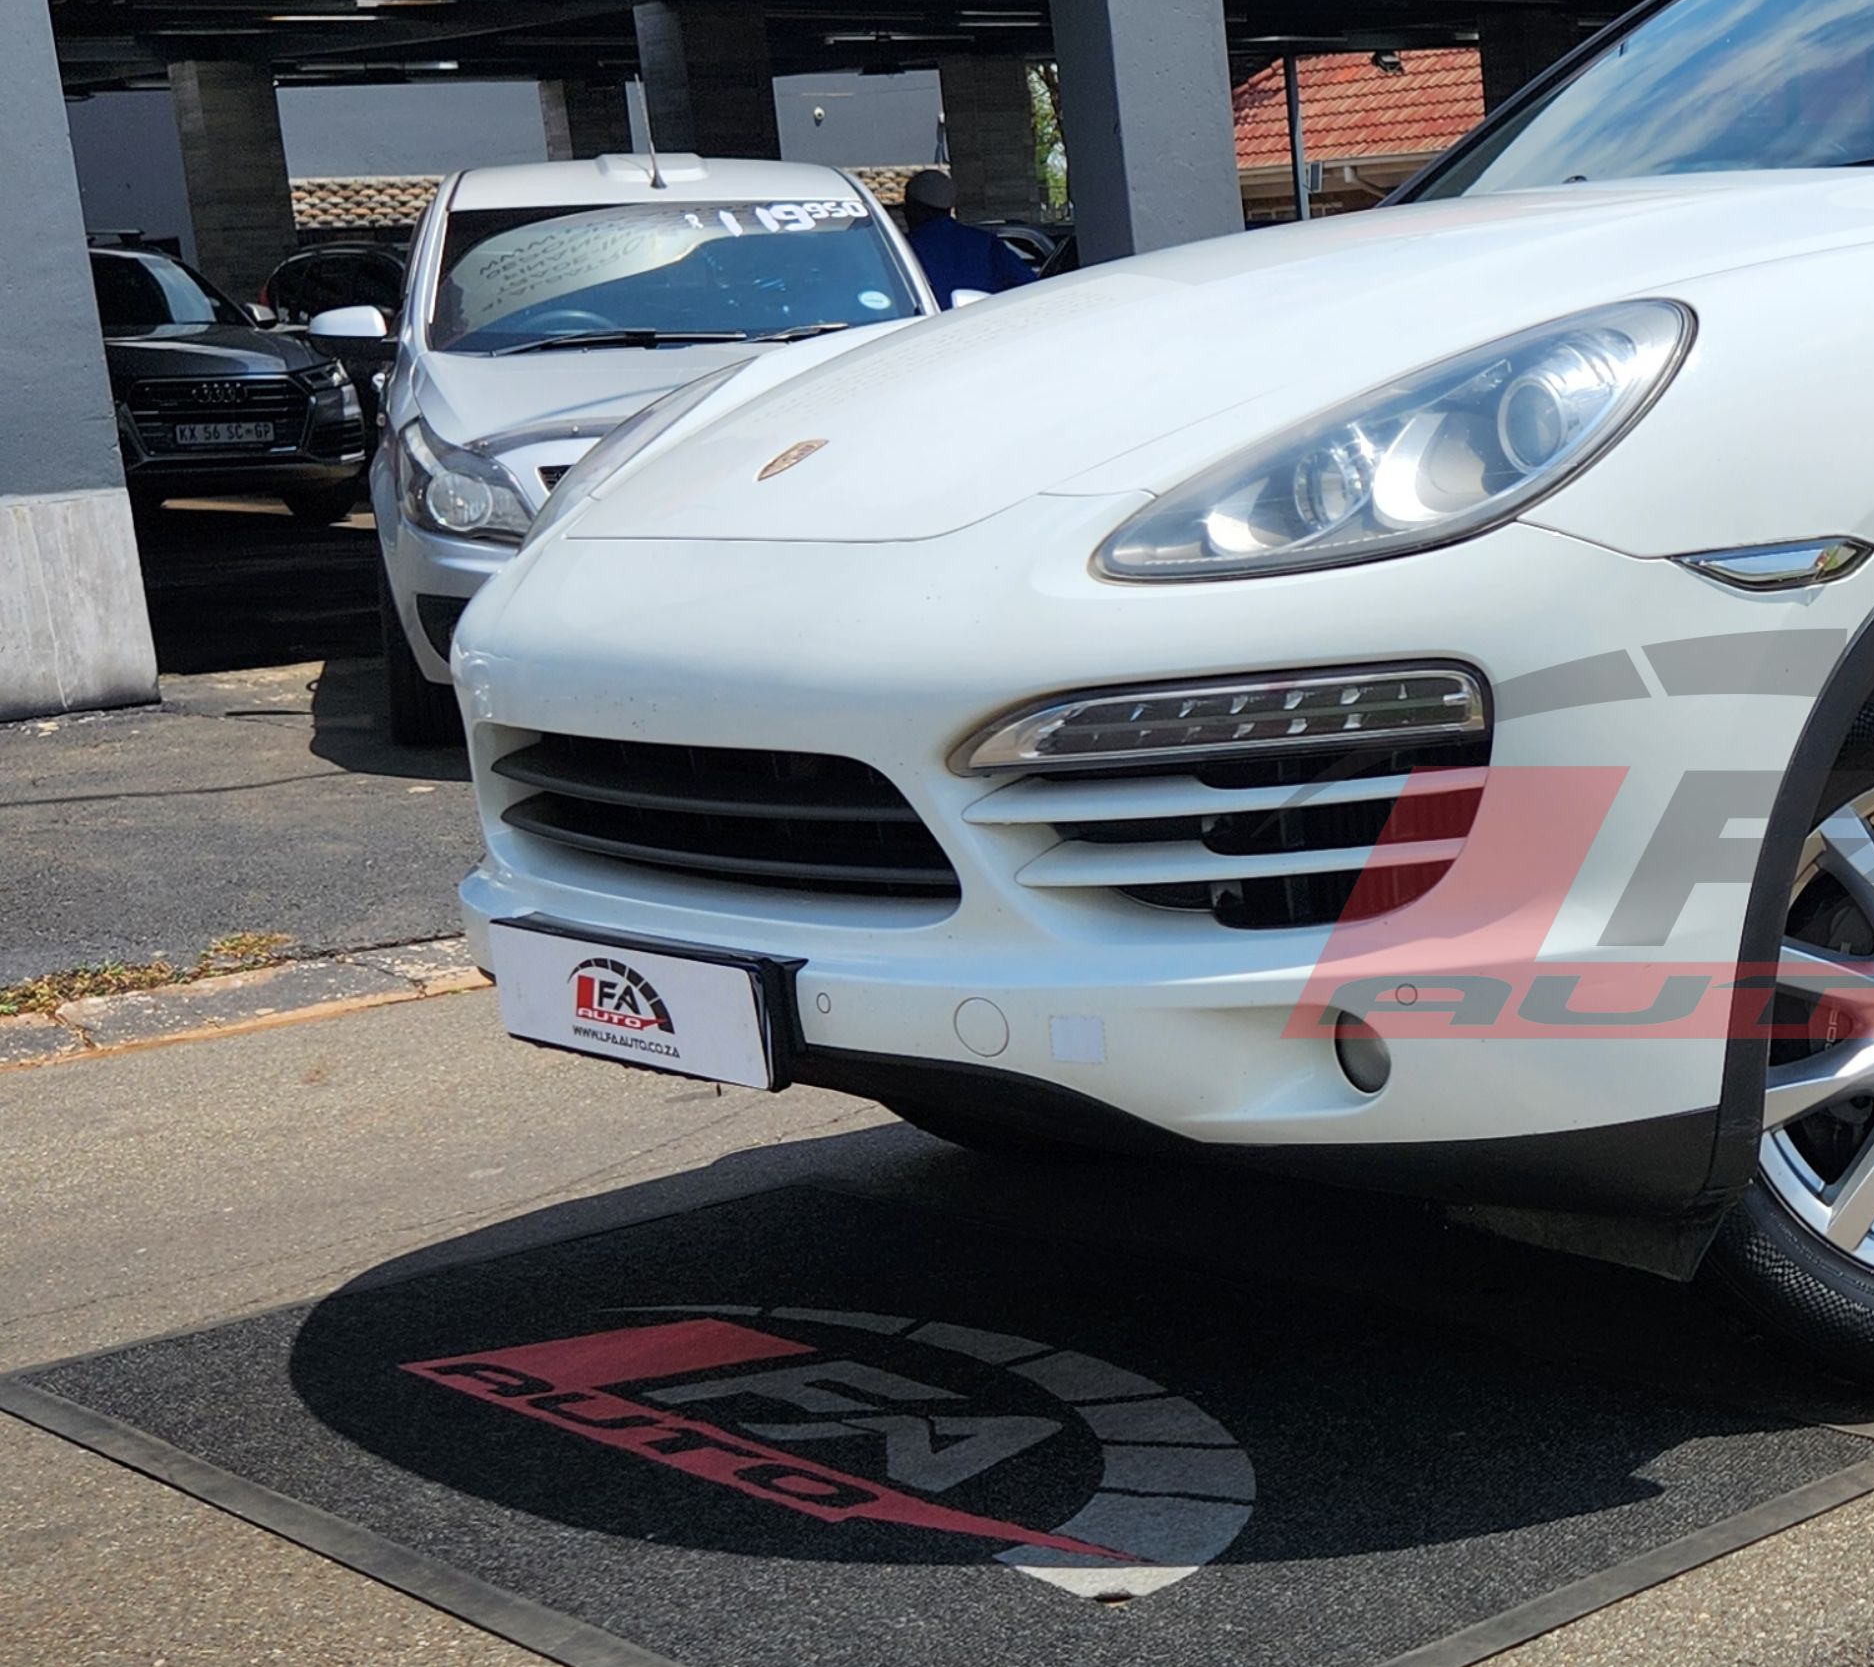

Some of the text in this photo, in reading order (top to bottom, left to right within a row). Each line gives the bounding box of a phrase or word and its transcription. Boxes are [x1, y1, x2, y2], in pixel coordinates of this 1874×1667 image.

[576, 975, 642, 1015] LFA
[578, 1008, 642, 1027] AUTO
[434, 1362, 877, 1502] AUTO
